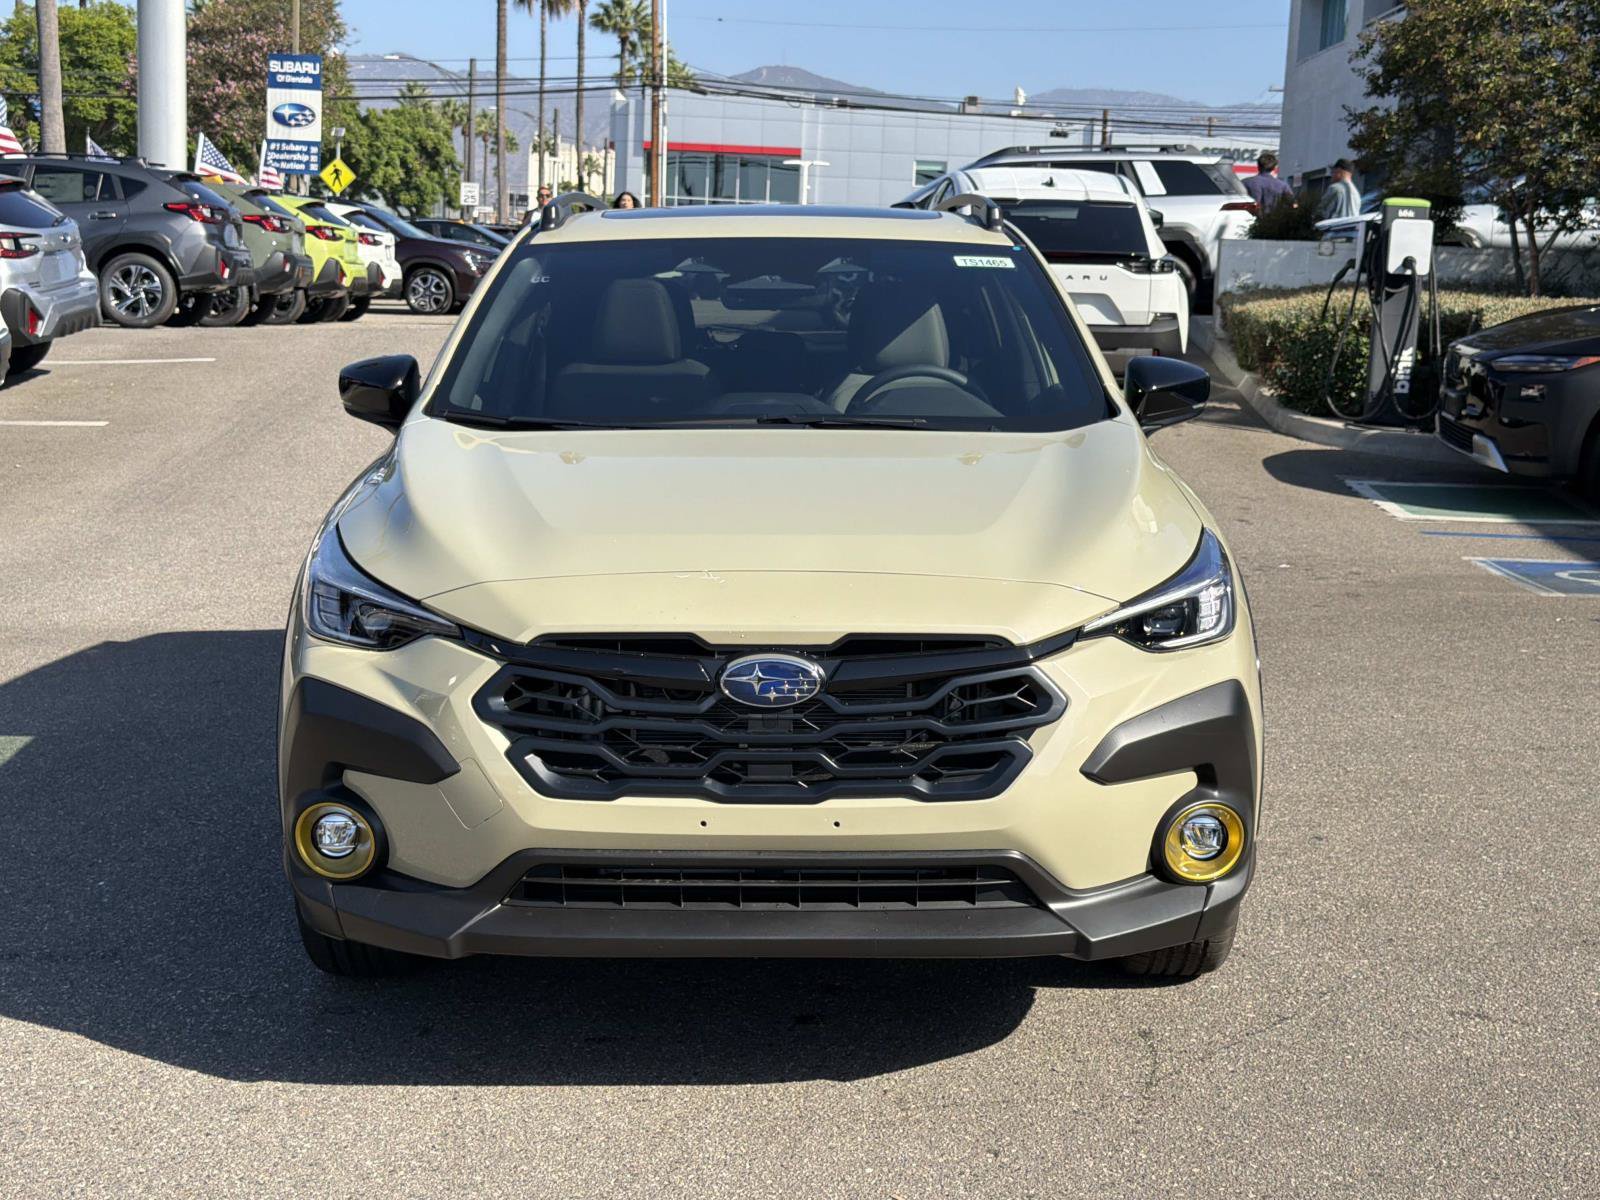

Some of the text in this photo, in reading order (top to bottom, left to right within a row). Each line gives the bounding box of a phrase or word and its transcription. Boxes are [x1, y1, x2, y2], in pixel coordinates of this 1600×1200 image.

[270, 60, 320, 74] SUBARU
[270, 143, 280, 151] #1
[281, 143, 308, 152] Subaru
[270, 152, 310, 162] Dealership
[280, 161, 306, 170] Nation
[463, 195, 477, 203] 25
[960, 258, 1008, 267] TS1465
